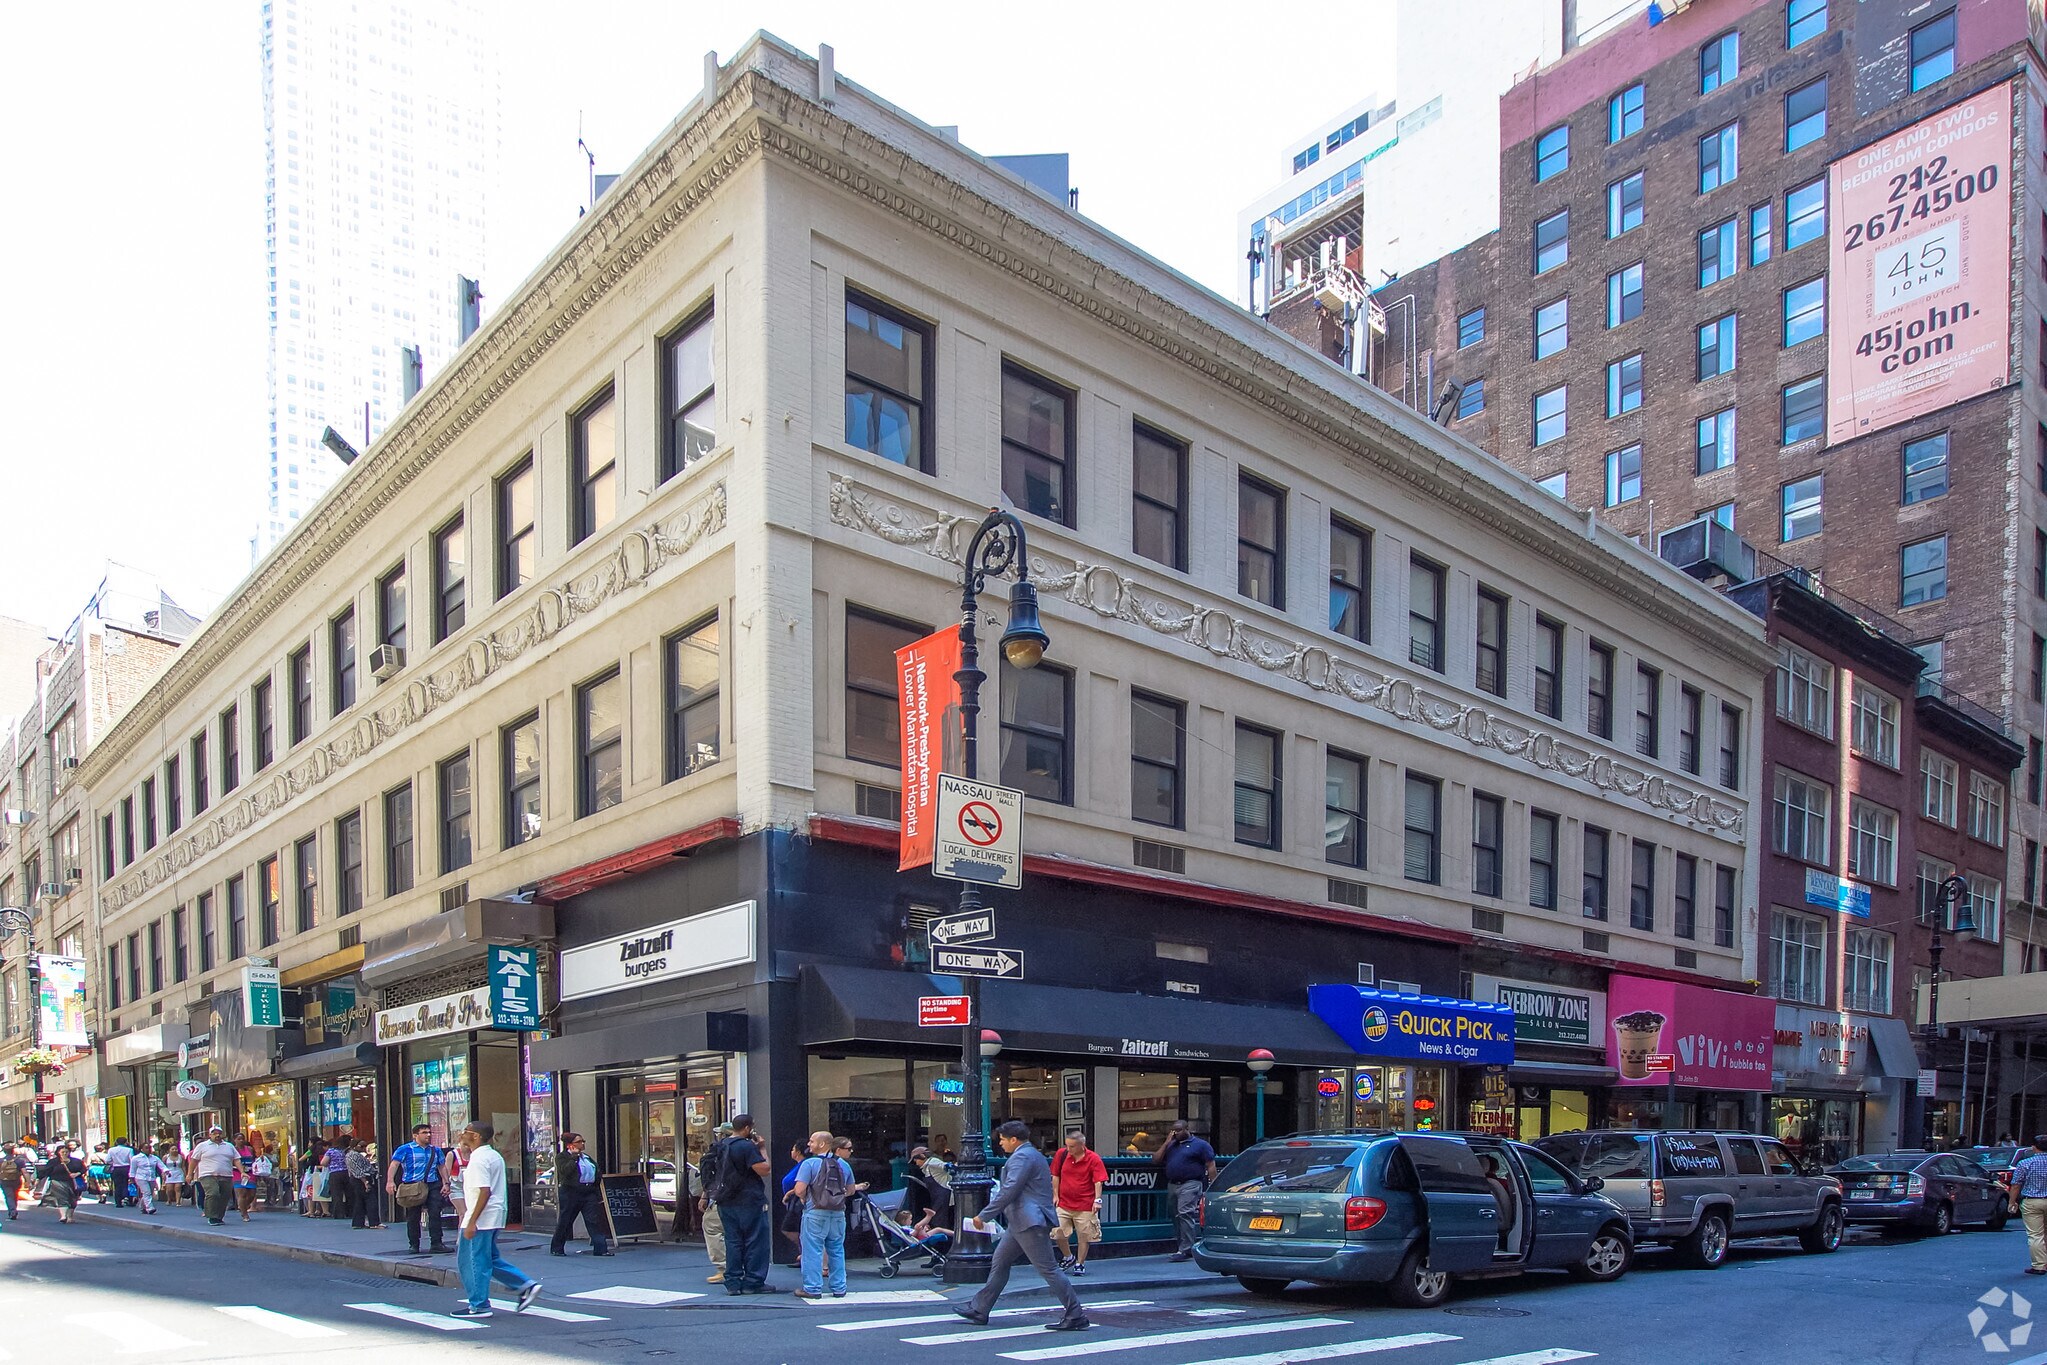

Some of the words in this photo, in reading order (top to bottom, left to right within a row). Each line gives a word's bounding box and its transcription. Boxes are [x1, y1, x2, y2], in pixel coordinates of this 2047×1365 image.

[1858, 144, 1891, 168] ONE
[1895, 127, 1931, 152] AND
[1934, 105, 1975, 133] TWO
[1842, 147, 1922, 193] BEDROOM
[1926, 111, 1999, 152] CONDOS
[1844, 164, 1998, 252] 267.4500
[1887, 236, 1947, 279] 45
[1891, 267, 1944, 297] JOHN
[1926, 284, 1960, 302] DUTCH
[1855, 301, 1980, 358] 45john.
[1880, 332, 1954, 374] com
[1941, 351, 1968, 366] SALES
[1969, 340, 1999, 357] AGENT
[903, 667, 915, 708] Lower
[915, 661, 930, 807] NewYork-Presbyterian
[906, 709, 919, 783] Manhattan
[944, 780, 993, 800] NASSAU
[996, 790, 1017, 800] STREET
[905, 784, 918, 837] Hospital
[999, 798, 1015, 807] MALL
[944, 844, 968, 857] LOCAL
[971, 849, 1014, 865] DELIVERIES
[938, 924, 957, 938] ONE
[964, 919, 986, 934] WAY
[620, 929, 674, 963] Zaitzeff
[51, 960, 74, 968] NYC
[625, 957, 667, 978] burgers
[945, 954, 972, 967] ONE
[983, 957, 1010, 970] WAY
[496, 949, 532, 1014] NAILS
[1500, 989, 1556, 1018] EYEBROW
[1558, 996, 1588, 1022] ZONE
[1398, 1010, 1453, 1038] QUICK
[1456, 1016, 1494, 1041] PICK
[1529, 1019, 1560, 1029] SALON
[1087, 1043, 1114, 1053] Burgers
[1121, 1038, 1169, 1056] Zaitzeff
[1174, 1048, 1210, 1058] Sandwiches
[1419, 1041, 1444, 1056] News
[1445, 1043, 1453, 1056] &
[1453, 1044, 1479, 1058] Cigar
[1677, 1034, 1728, 1068] ViVi
[1819, 1047, 1856, 1066] OUTLET
[1729, 1058, 1754, 1070] bubble
[1754, 1061, 1766, 1071] tea
[1317, 1081, 1340, 1093] OPEN
[1103, 1169, 1158, 1190] ubway
